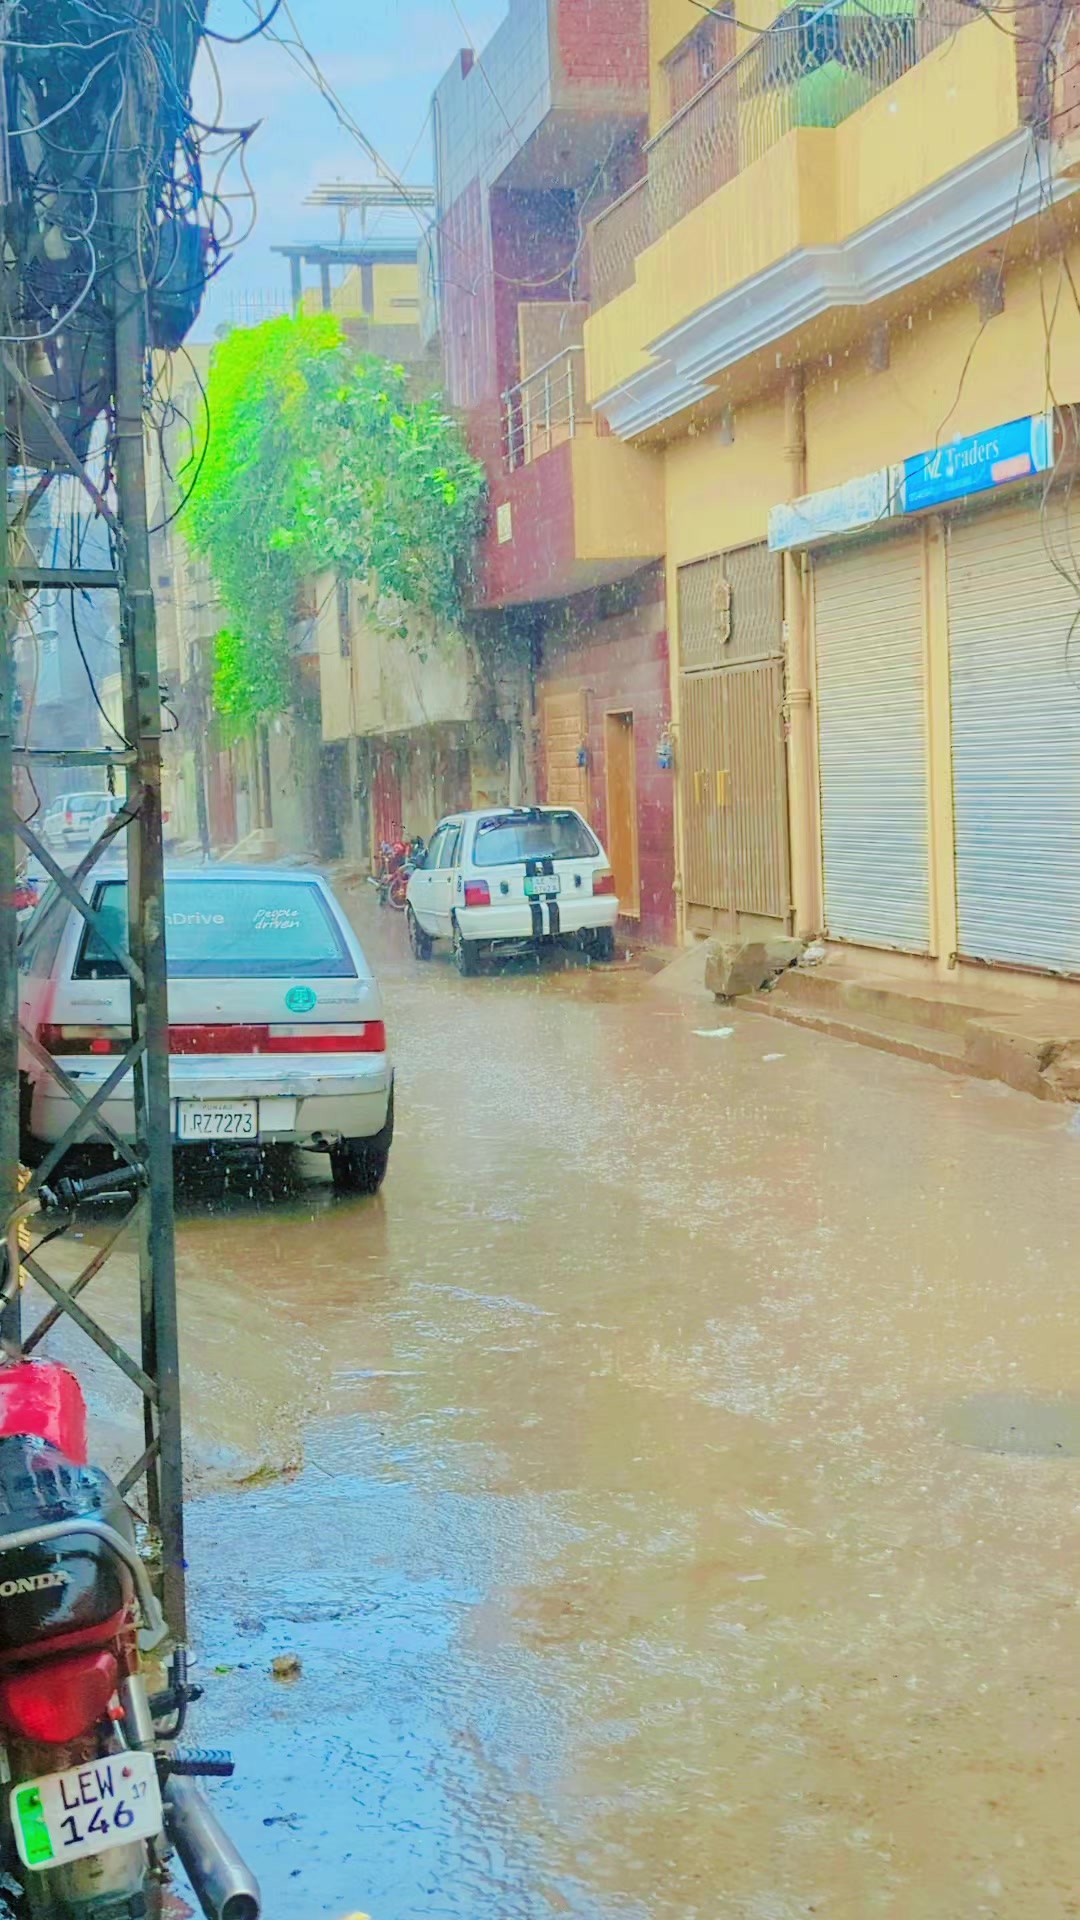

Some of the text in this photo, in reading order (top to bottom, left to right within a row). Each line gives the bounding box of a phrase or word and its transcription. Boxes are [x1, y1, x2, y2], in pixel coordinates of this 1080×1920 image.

[945, 439, 1000, 476] Traders
[164, 911, 226, 926] nDrive
[254, 916, 301, 930] driven
[0, 1569, 75, 1598] ONDA
[59, 1764, 148, 1811] LEW 17
[60, 1799, 135, 1847] 146
